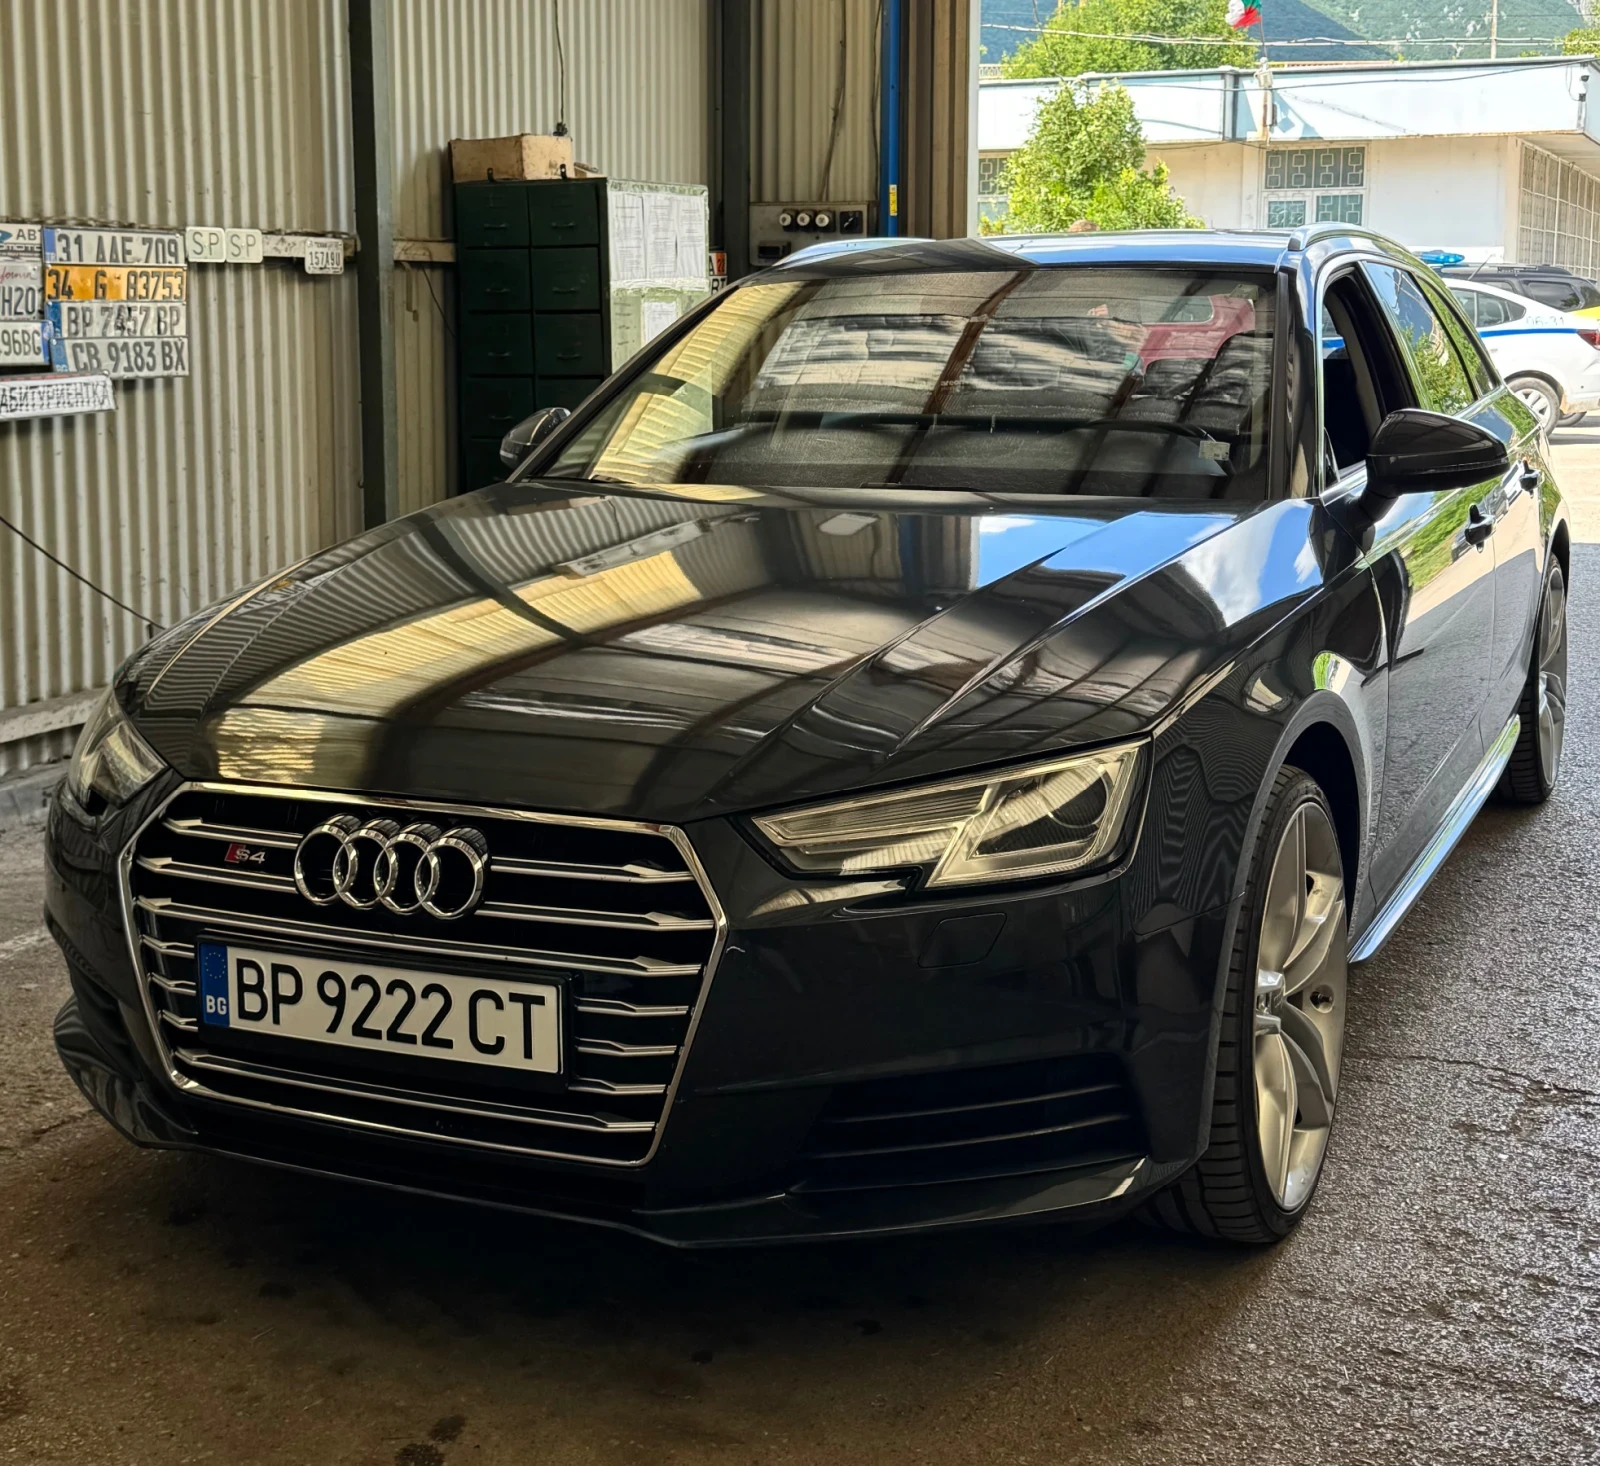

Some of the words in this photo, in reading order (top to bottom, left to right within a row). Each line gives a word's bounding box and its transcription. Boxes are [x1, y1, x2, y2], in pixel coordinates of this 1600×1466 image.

[57, 233, 83, 262] 31
[142, 238, 179, 264] 709
[192, 231, 220, 256] SP
[230, 233, 257, 258] SP
[47, 269, 73, 300] 34
[127, 270, 184, 301] 83753
[67, 306, 93, 337] BP
[156, 306, 181, 336] BP
[107, 341, 157, 373] 9183
[161, 341, 186, 372] BX
[234, 848, 266, 864] S4
[205, 994, 228, 1015] BG
[235, 957, 304, 1026] BP
[316, 969, 454, 1050] 9222
[468, 988, 546, 1060] CT
